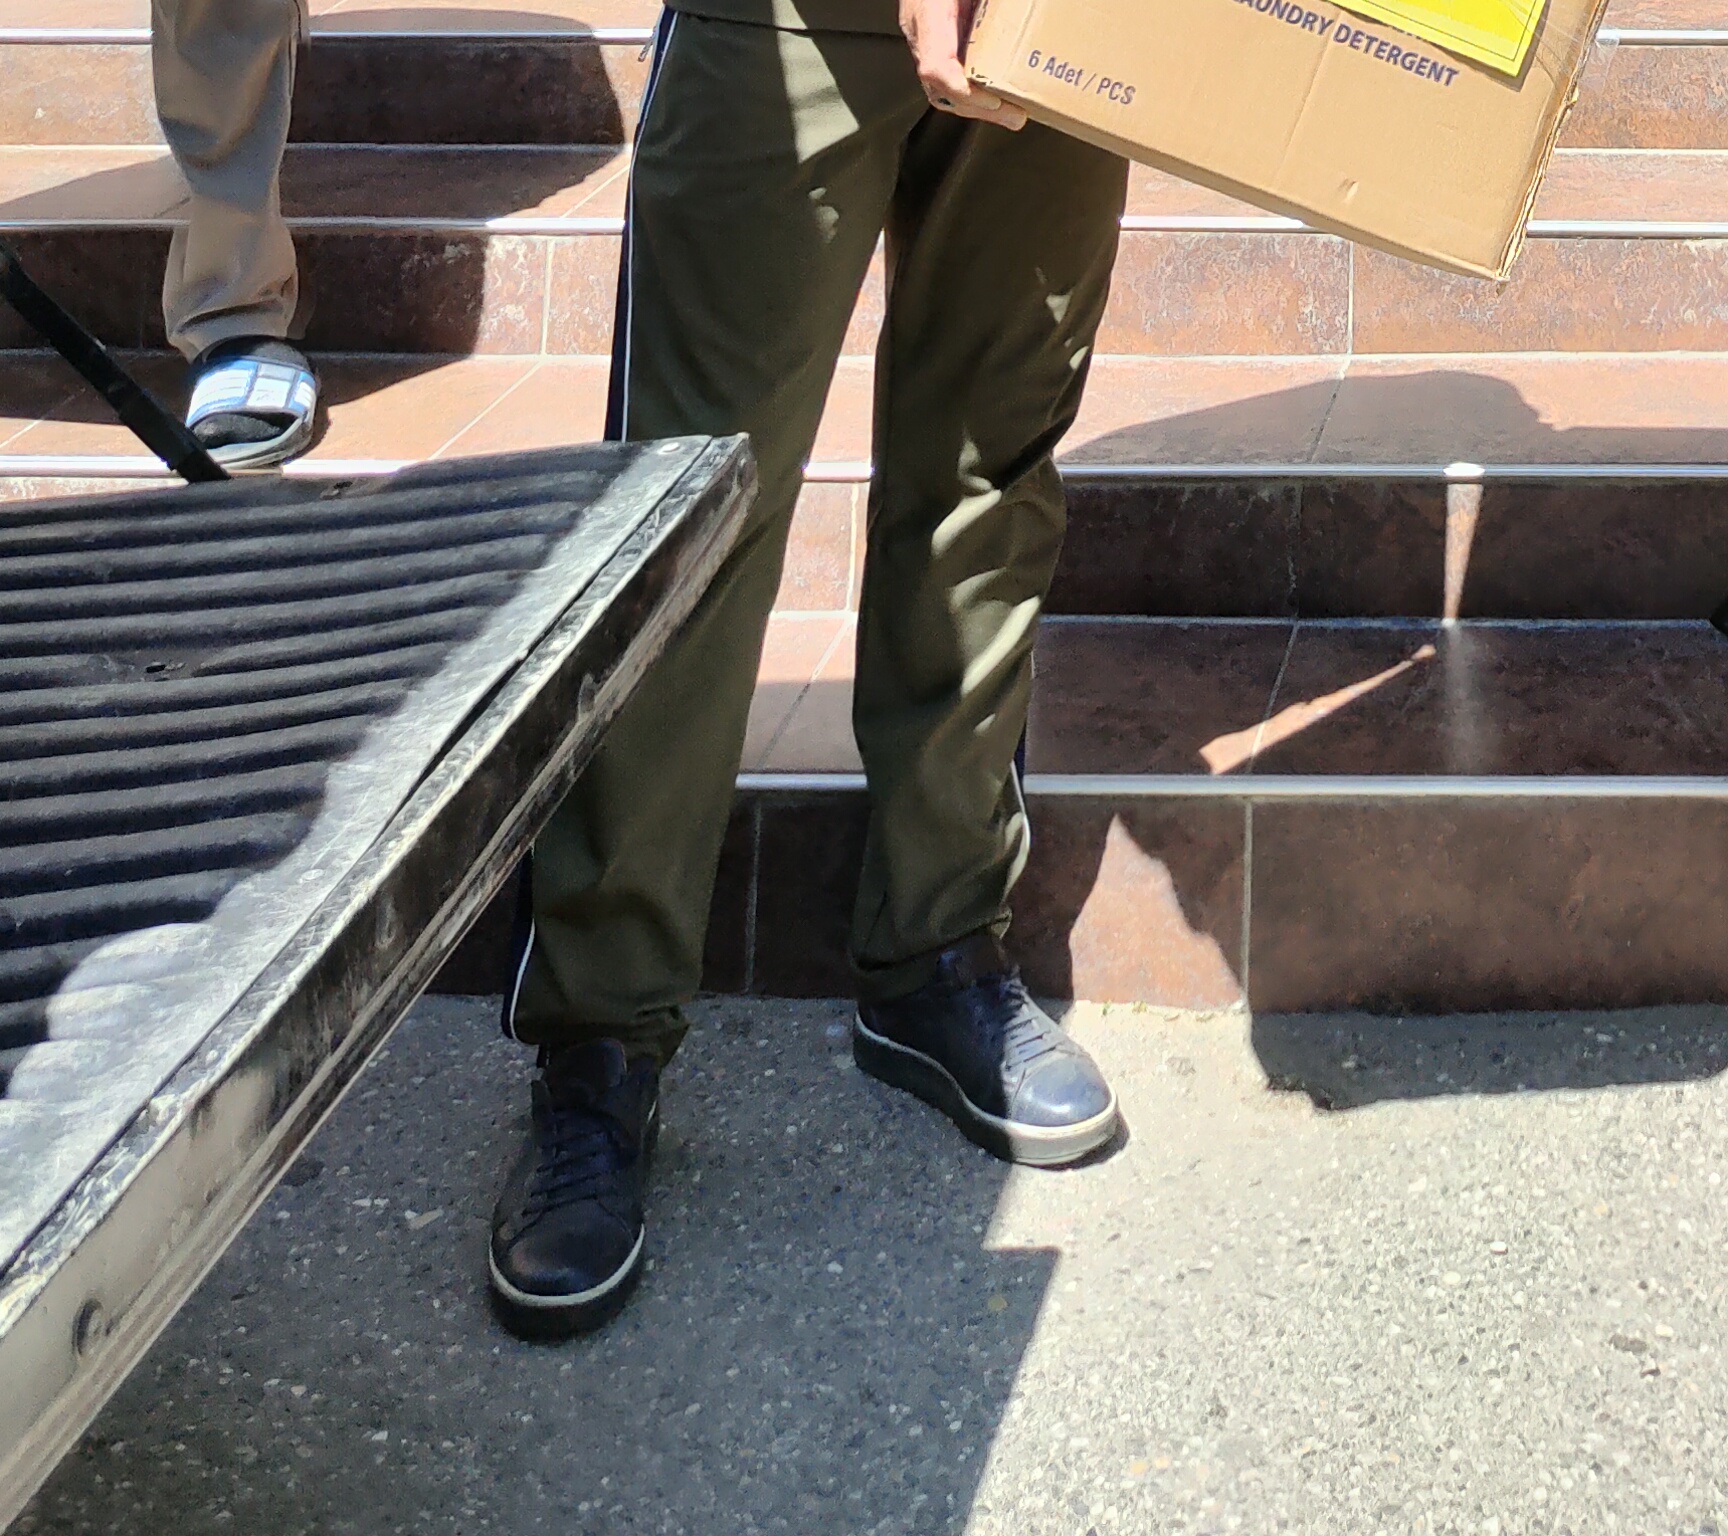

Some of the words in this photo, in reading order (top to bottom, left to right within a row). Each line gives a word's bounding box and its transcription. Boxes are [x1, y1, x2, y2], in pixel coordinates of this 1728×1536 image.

[1028, 50, 1042, 68] 6
[1043, 56, 1083, 86] Adet
[1082, 73, 1096, 91] /
[1096, 77, 1136, 105] PCS
[1333, 23, 1460, 87] DETERGENT
